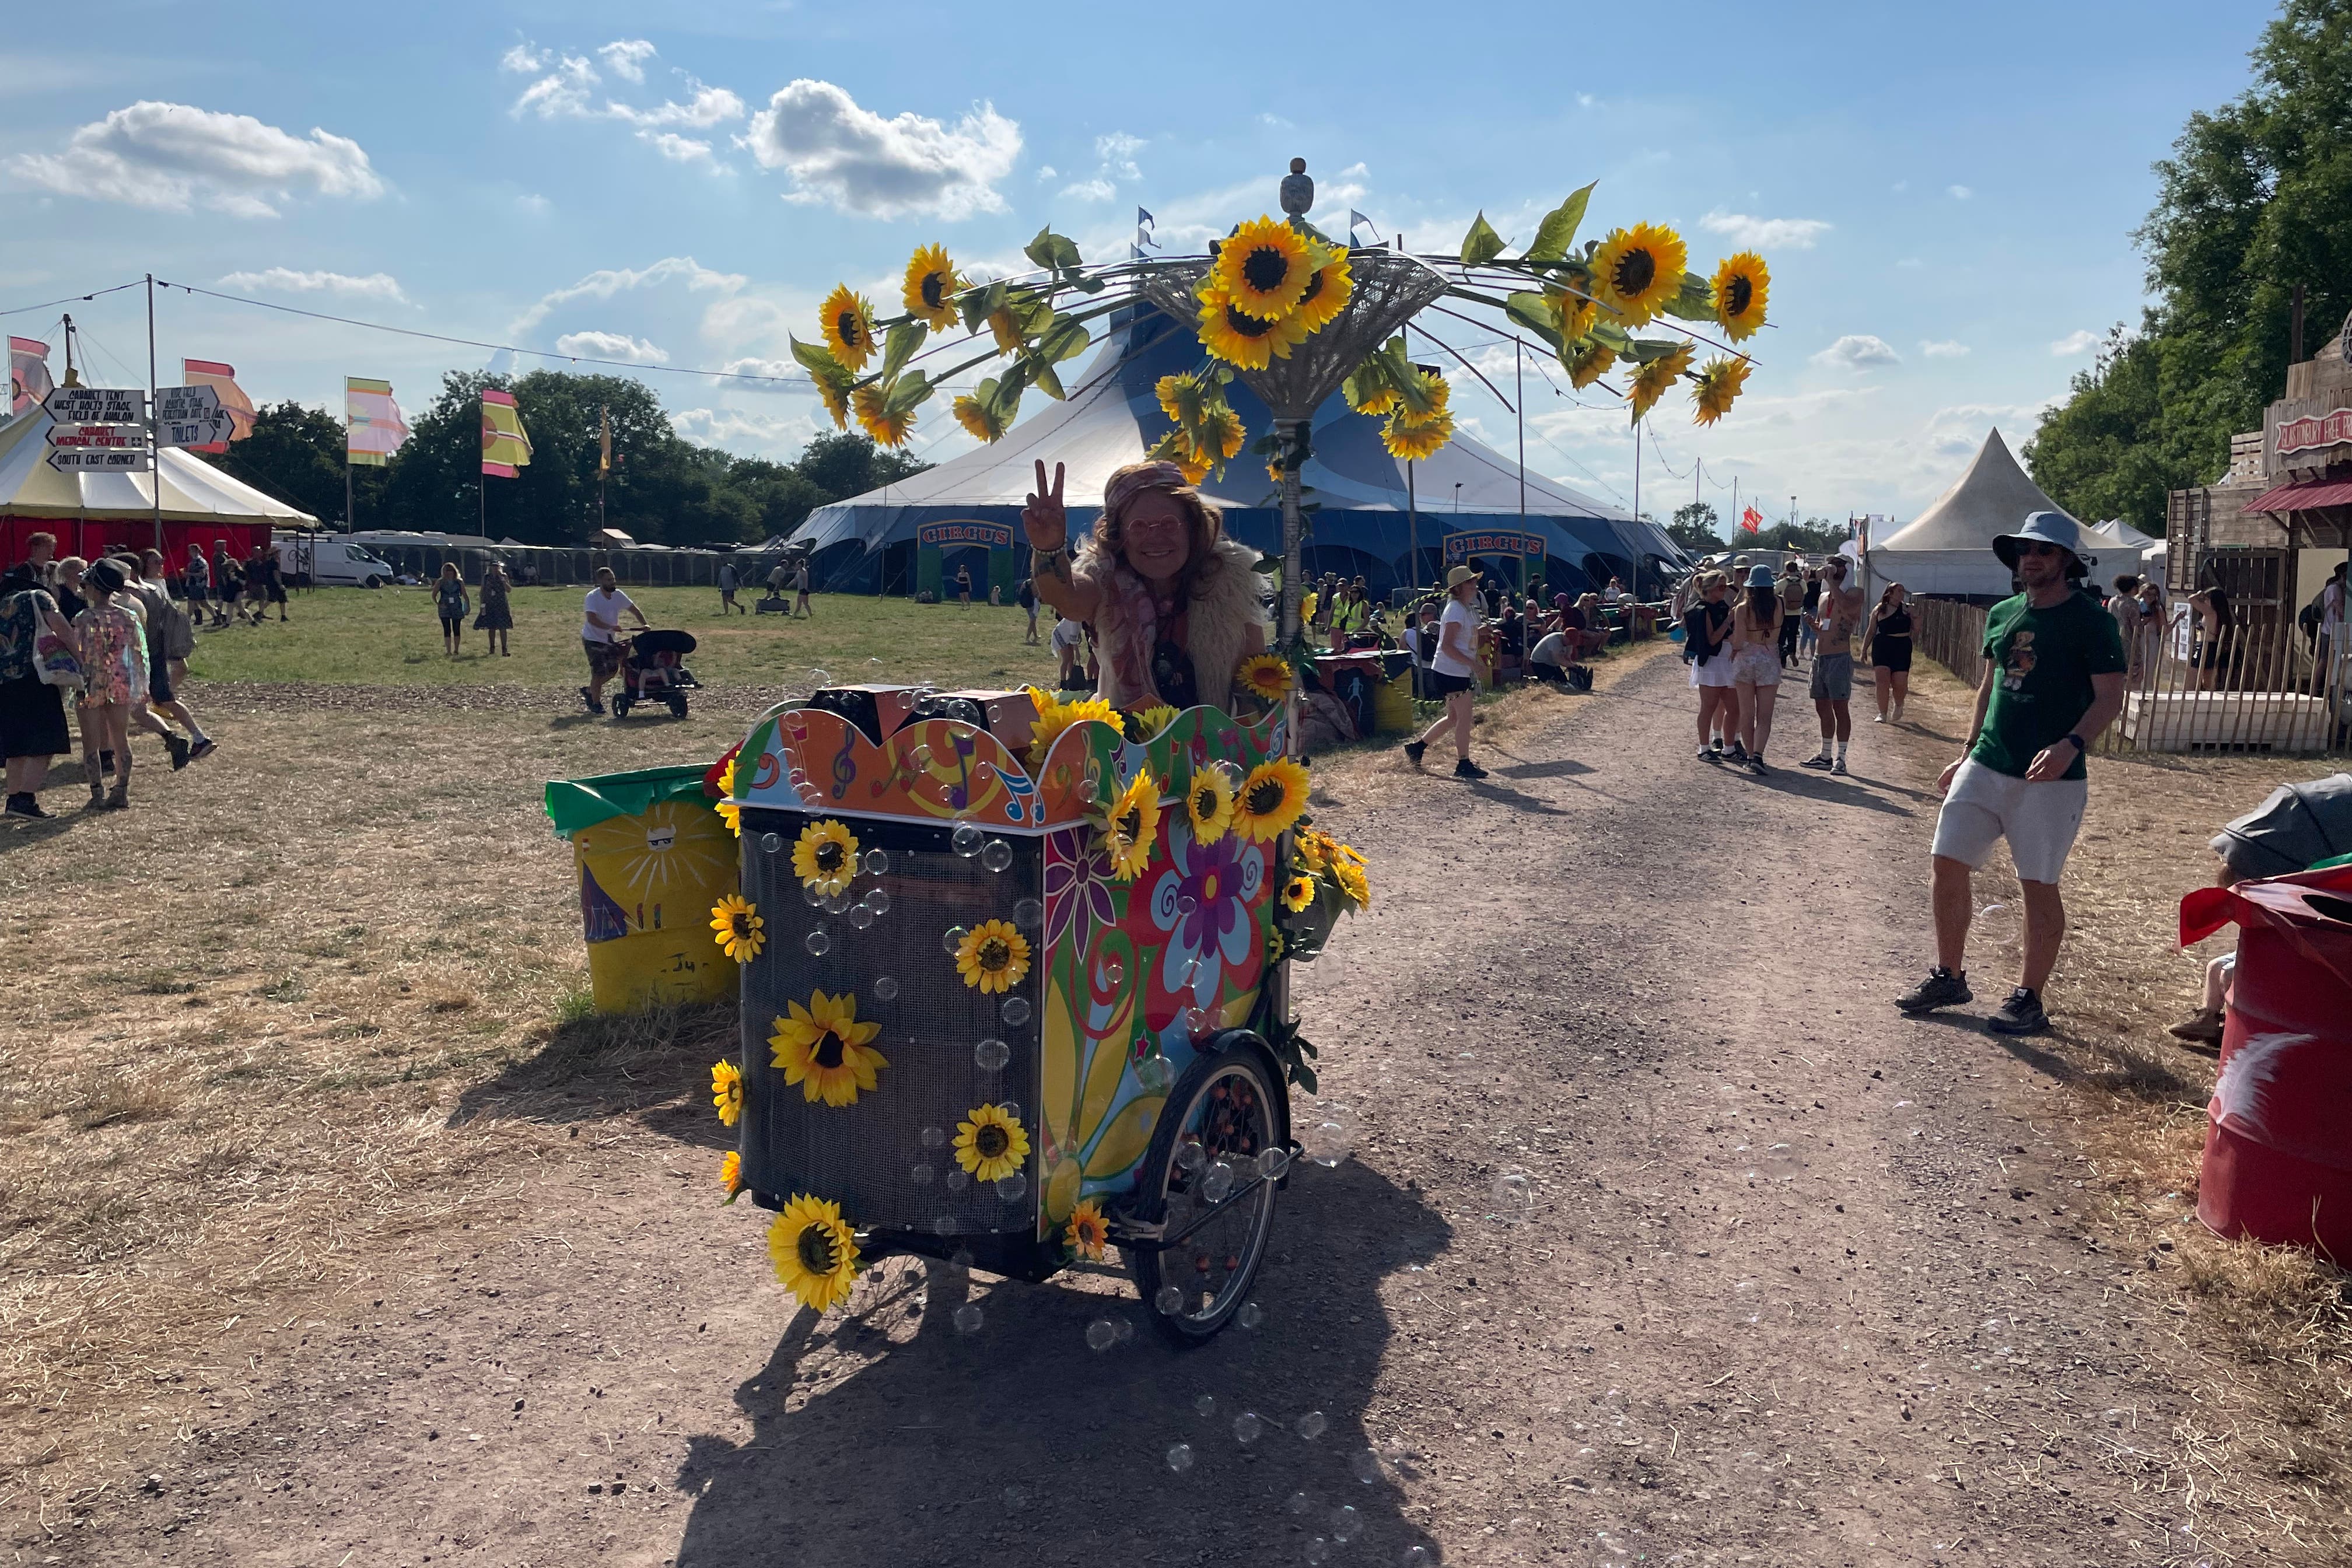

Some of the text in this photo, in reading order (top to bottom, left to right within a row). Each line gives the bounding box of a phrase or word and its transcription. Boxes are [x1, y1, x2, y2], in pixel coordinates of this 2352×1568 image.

[69, 390, 125, 401] CABARET TENT
[54, 400, 131, 411] WEST HOLTS STAGE
[68, 411, 134, 421] FIELD OF AVALON
[79, 426, 116, 436] CABARET
[172, 425, 198, 443] TOILETS
[2281, 420, 2322, 448] GLASTONBURY
[2324, 417, 2340, 441] FREE
[55, 436, 127, 446] MEDICAL CENTRE
[58, 454, 135, 465] SOUTH EAST CORNER
[922, 526, 1009, 544] CIRCUS
[1448, 536, 1542, 554] CIRCUS
